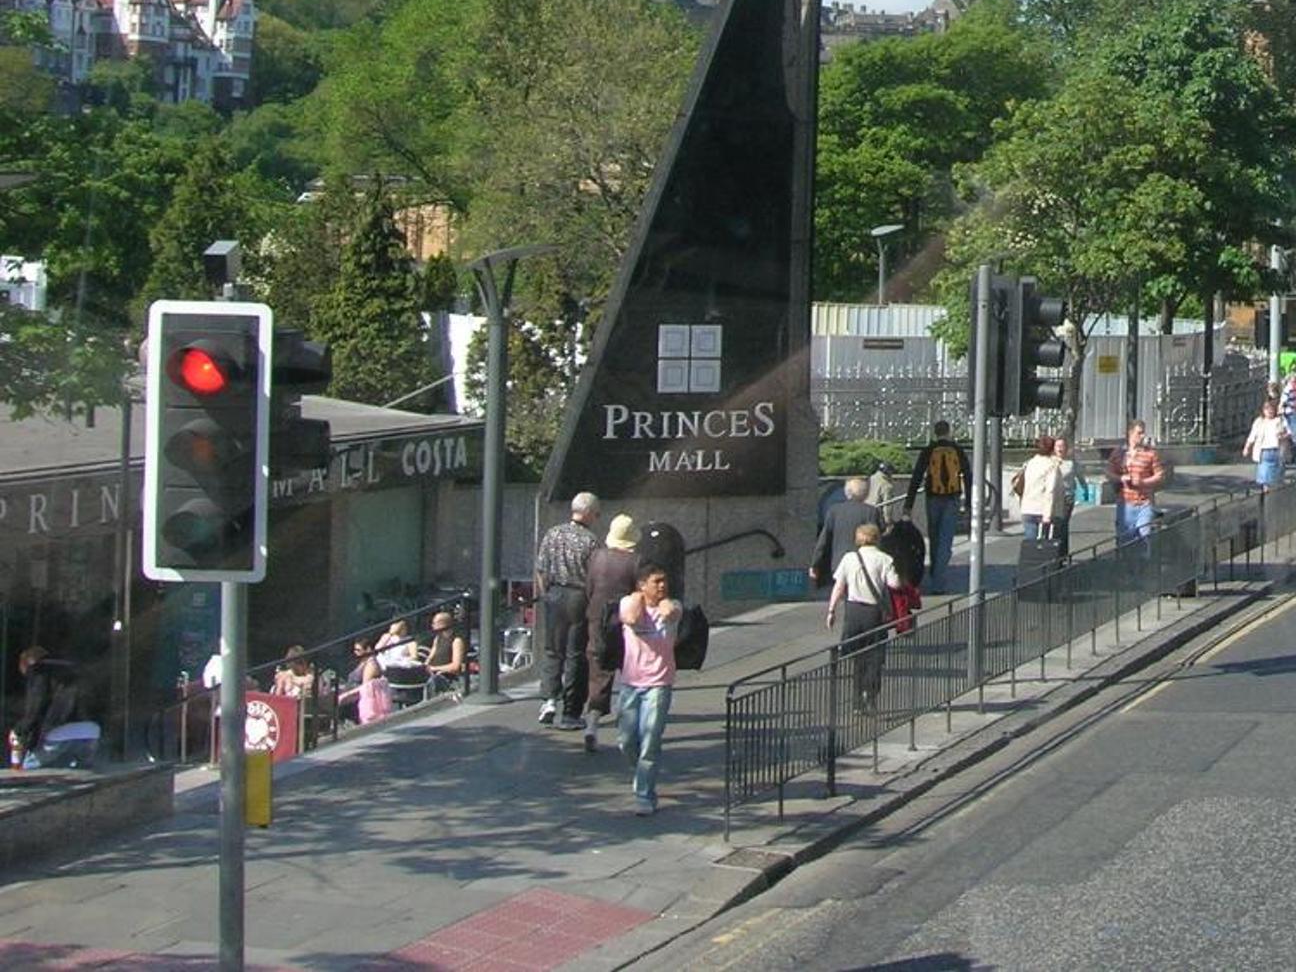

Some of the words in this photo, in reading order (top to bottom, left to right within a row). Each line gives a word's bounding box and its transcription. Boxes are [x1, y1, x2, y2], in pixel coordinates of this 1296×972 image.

[602, 401, 776, 439] PRINCES
[402, 436, 467, 476] COSTA
[648, 449, 730, 472] MALL
